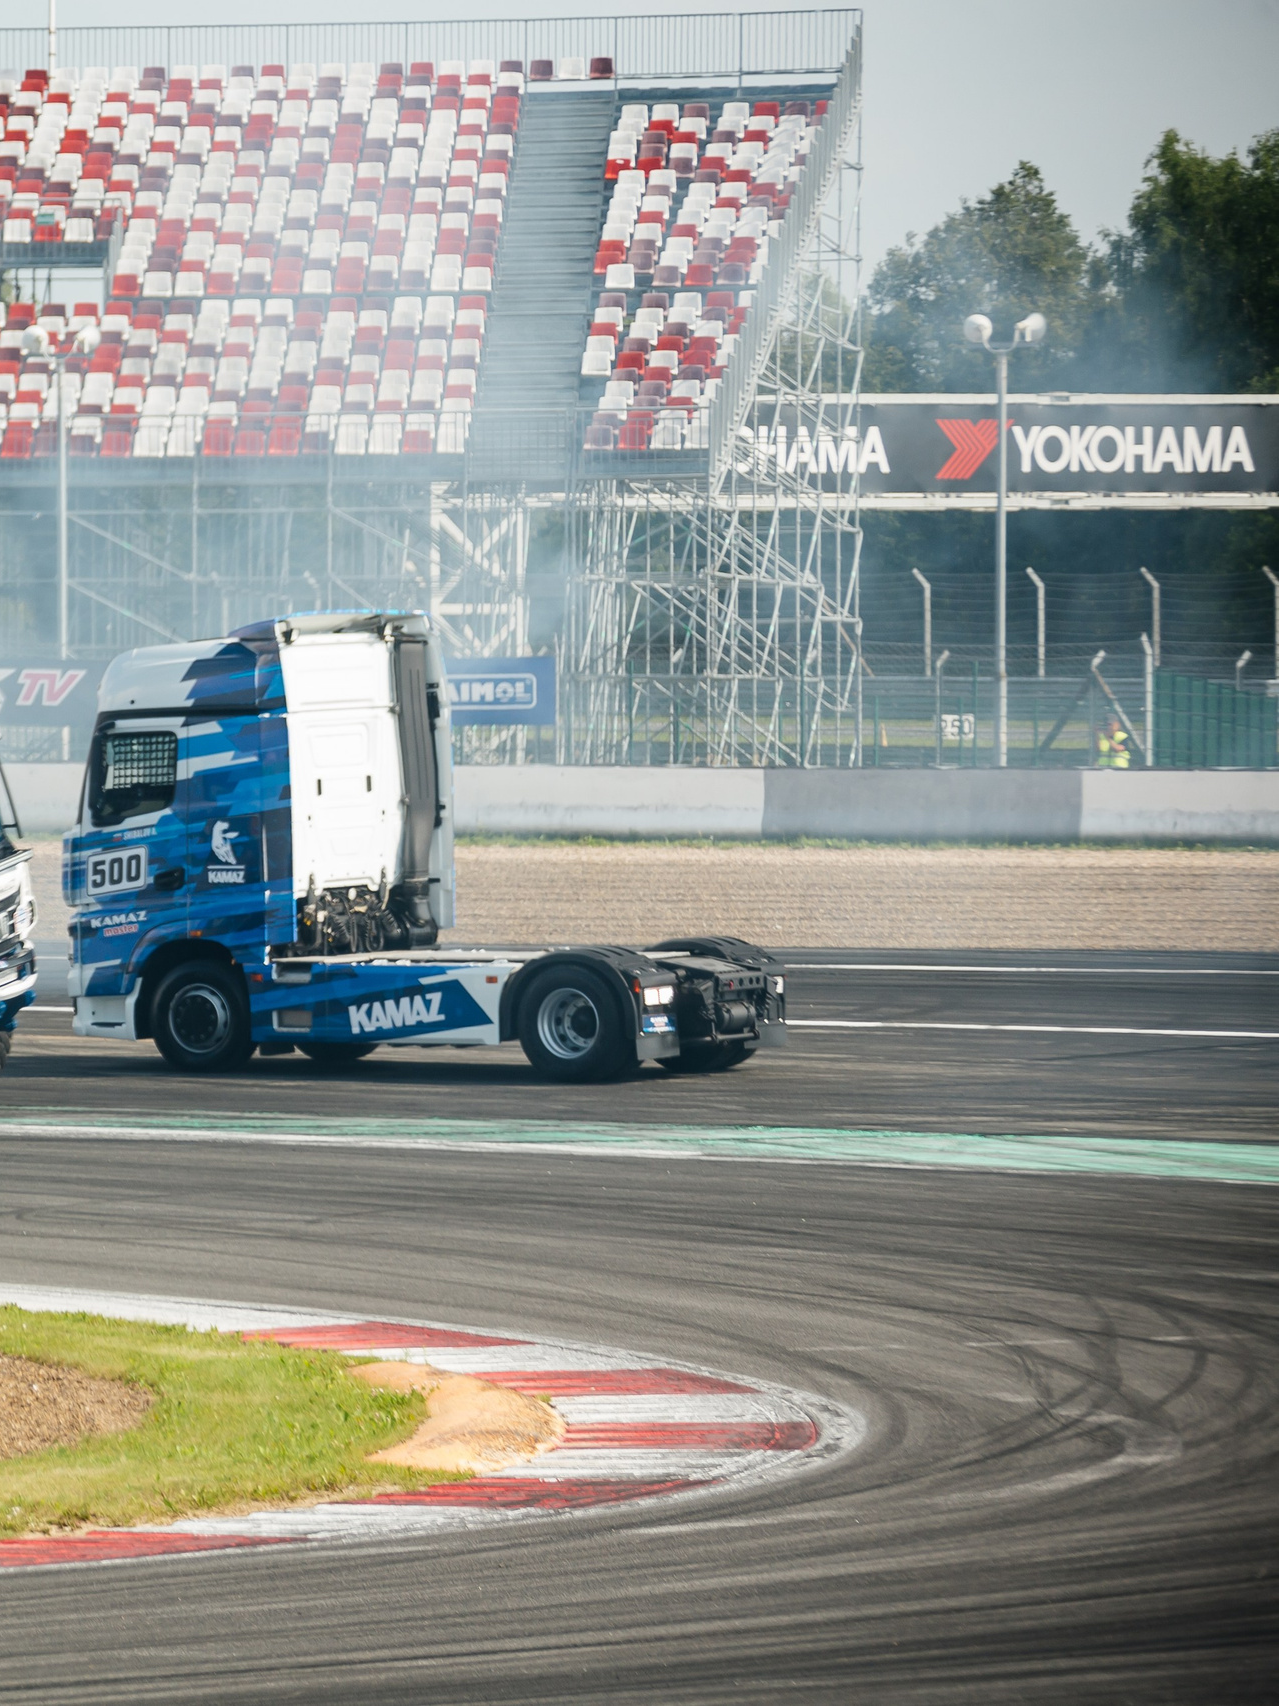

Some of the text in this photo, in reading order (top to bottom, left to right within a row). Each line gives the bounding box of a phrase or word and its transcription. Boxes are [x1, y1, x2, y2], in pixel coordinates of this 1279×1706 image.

[1013, 425, 1255, 474] YOKOHAMA
[16, 669, 87, 706] TV
[91, 854, 141, 889] 500
[208, 871, 245, 884] KAMAZ
[90, 910, 147, 929] KAMAZ
[103, 924, 139, 937] master
[348, 992, 446, 1034] KAMAZ
